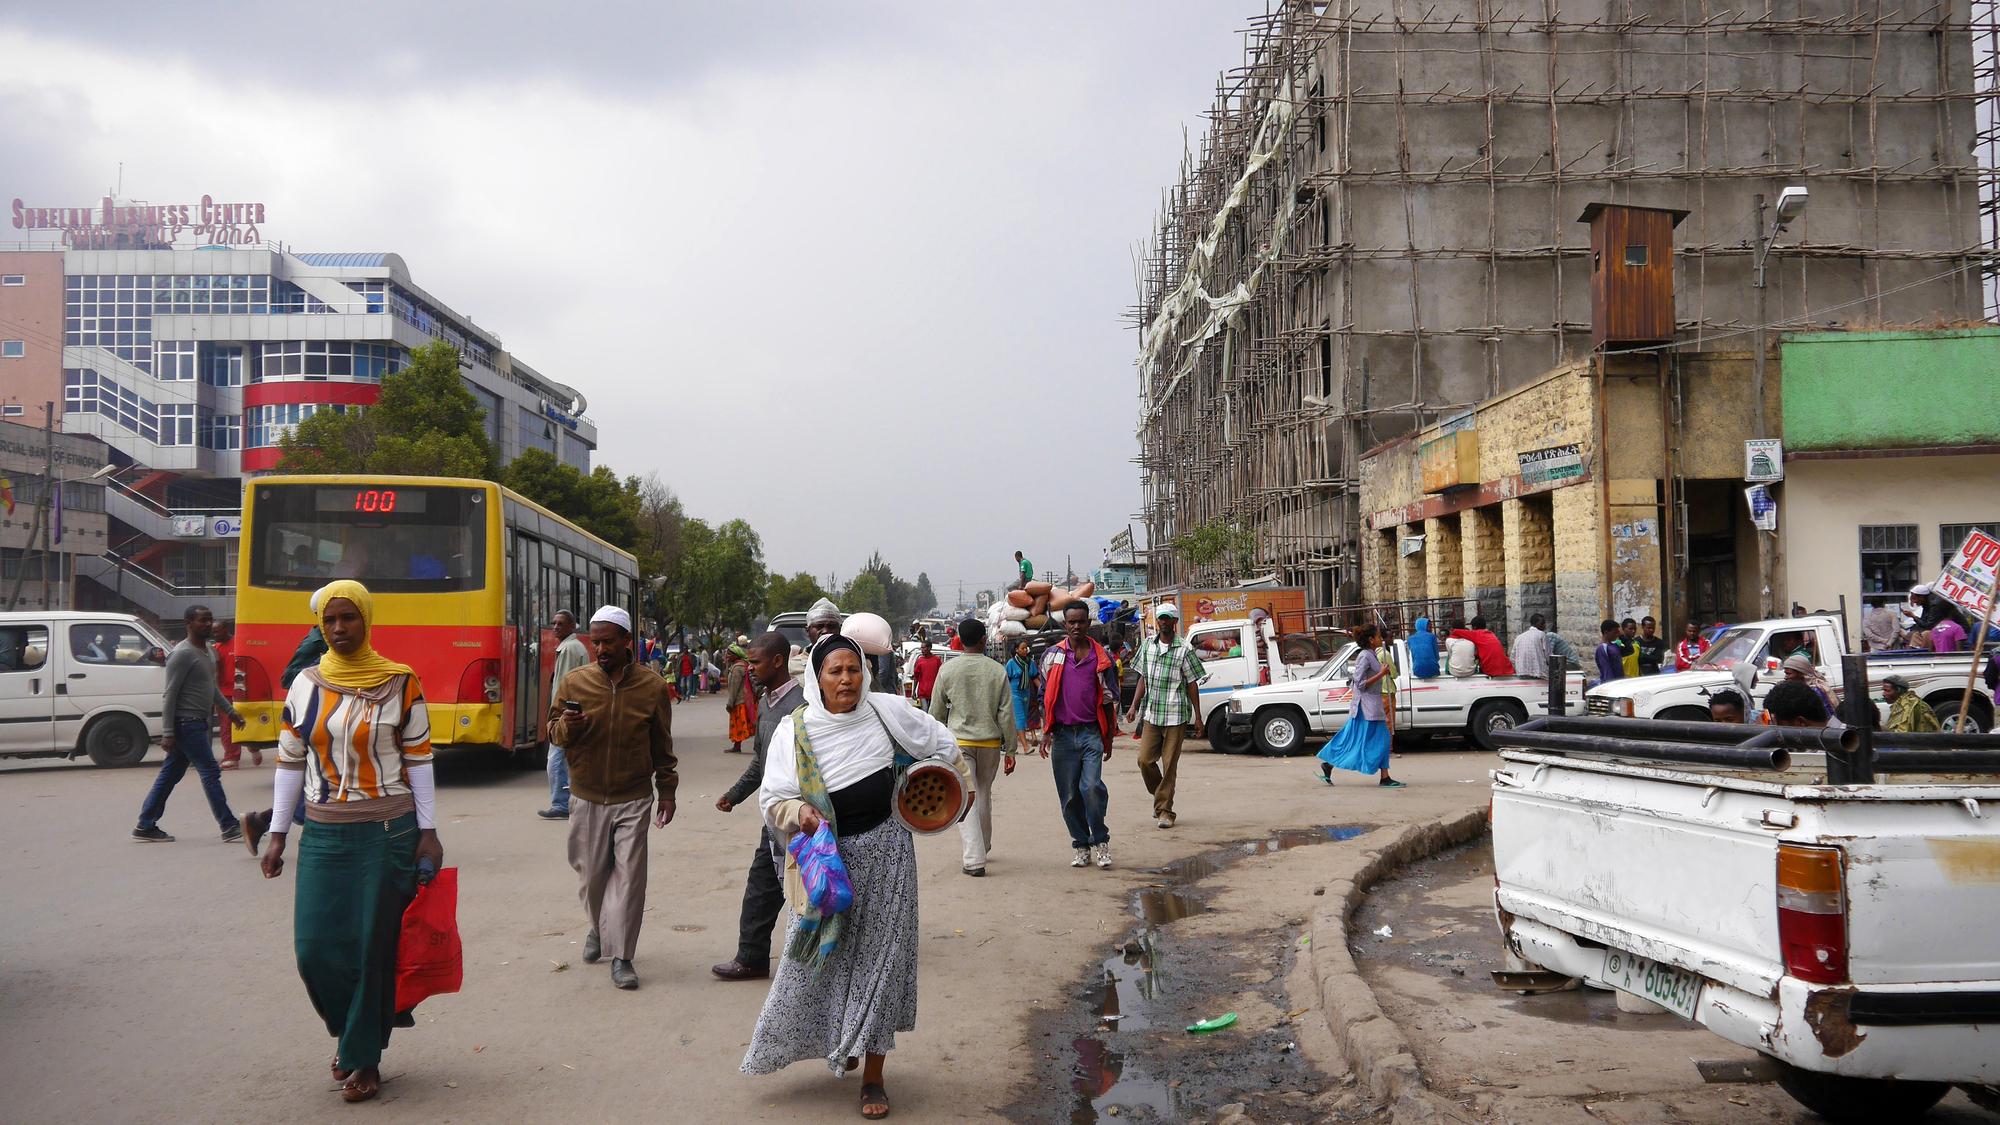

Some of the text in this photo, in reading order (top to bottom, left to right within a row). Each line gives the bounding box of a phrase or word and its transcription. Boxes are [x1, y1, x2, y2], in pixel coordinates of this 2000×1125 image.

[201, 194, 265, 225] CENTER
[355, 490, 395, 512] 100
[1212, 597, 1237, 606] makes
[1645, 962, 1690, 1008] 60543
